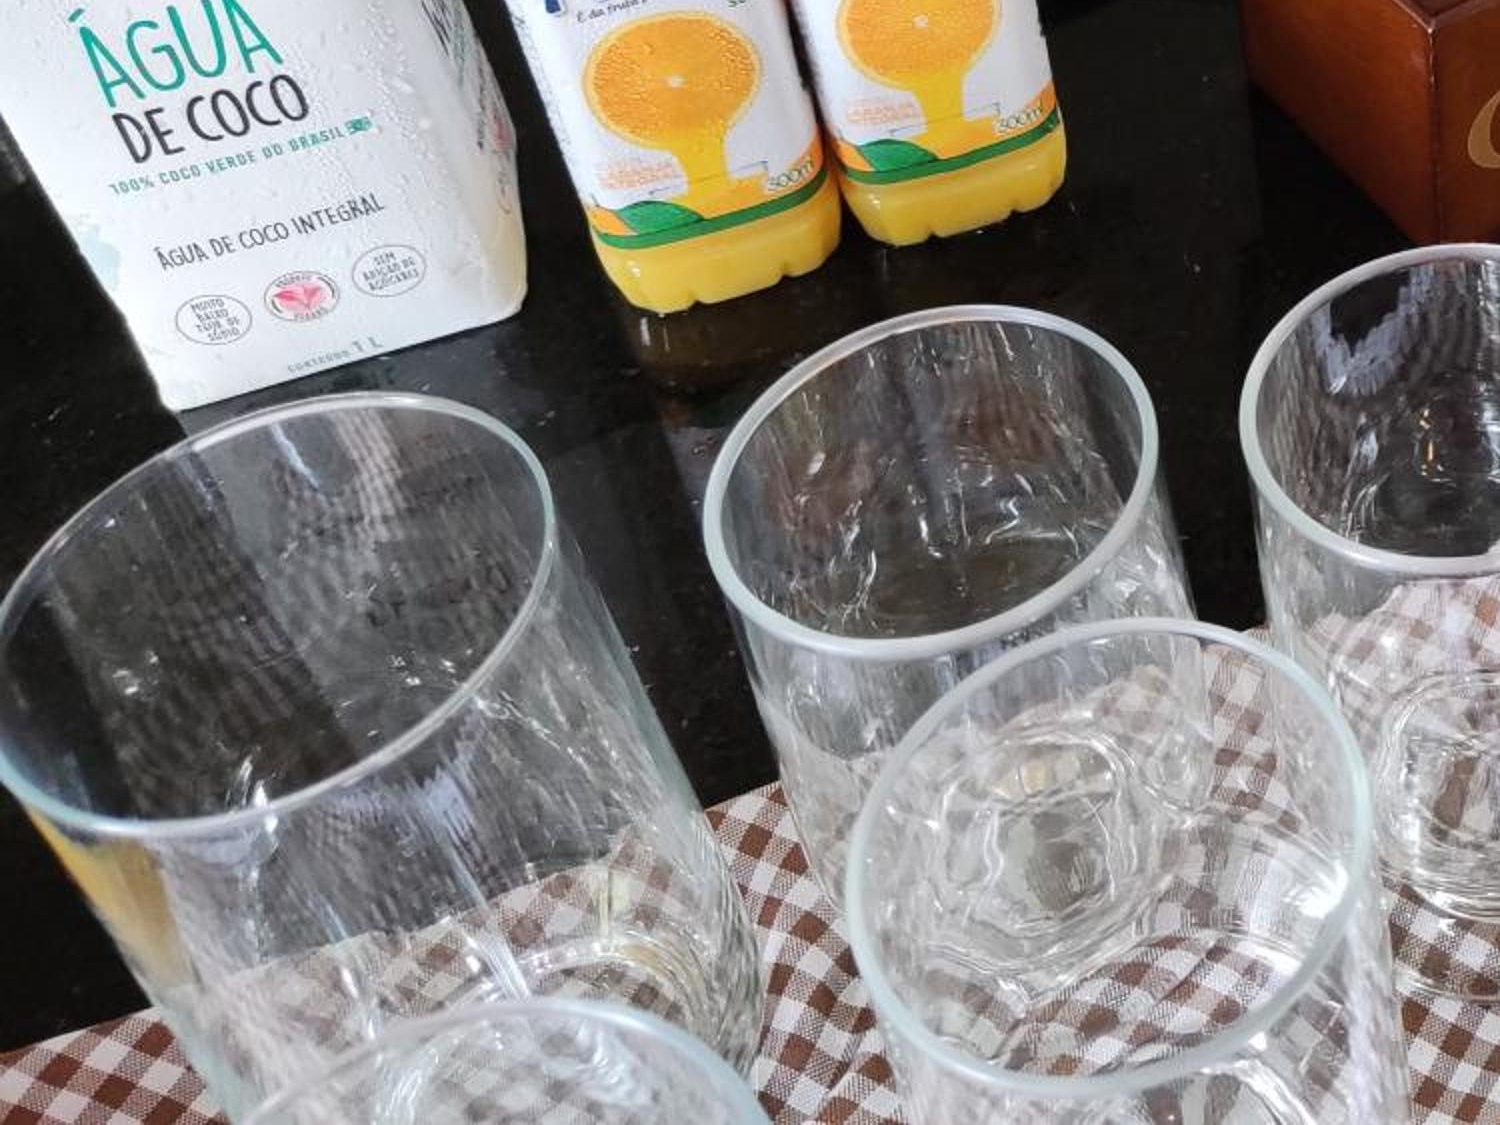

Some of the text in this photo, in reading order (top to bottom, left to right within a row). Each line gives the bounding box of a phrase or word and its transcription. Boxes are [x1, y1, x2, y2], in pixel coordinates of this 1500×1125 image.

[588, 7, 605, 18] da
[112, 74, 310, 164] DE COCO
[108, 126, 345, 196] 100% COCO VERDE DO BRASIL
[153, 192, 385, 271] ÁGUA DE COCO INTEGRAL
